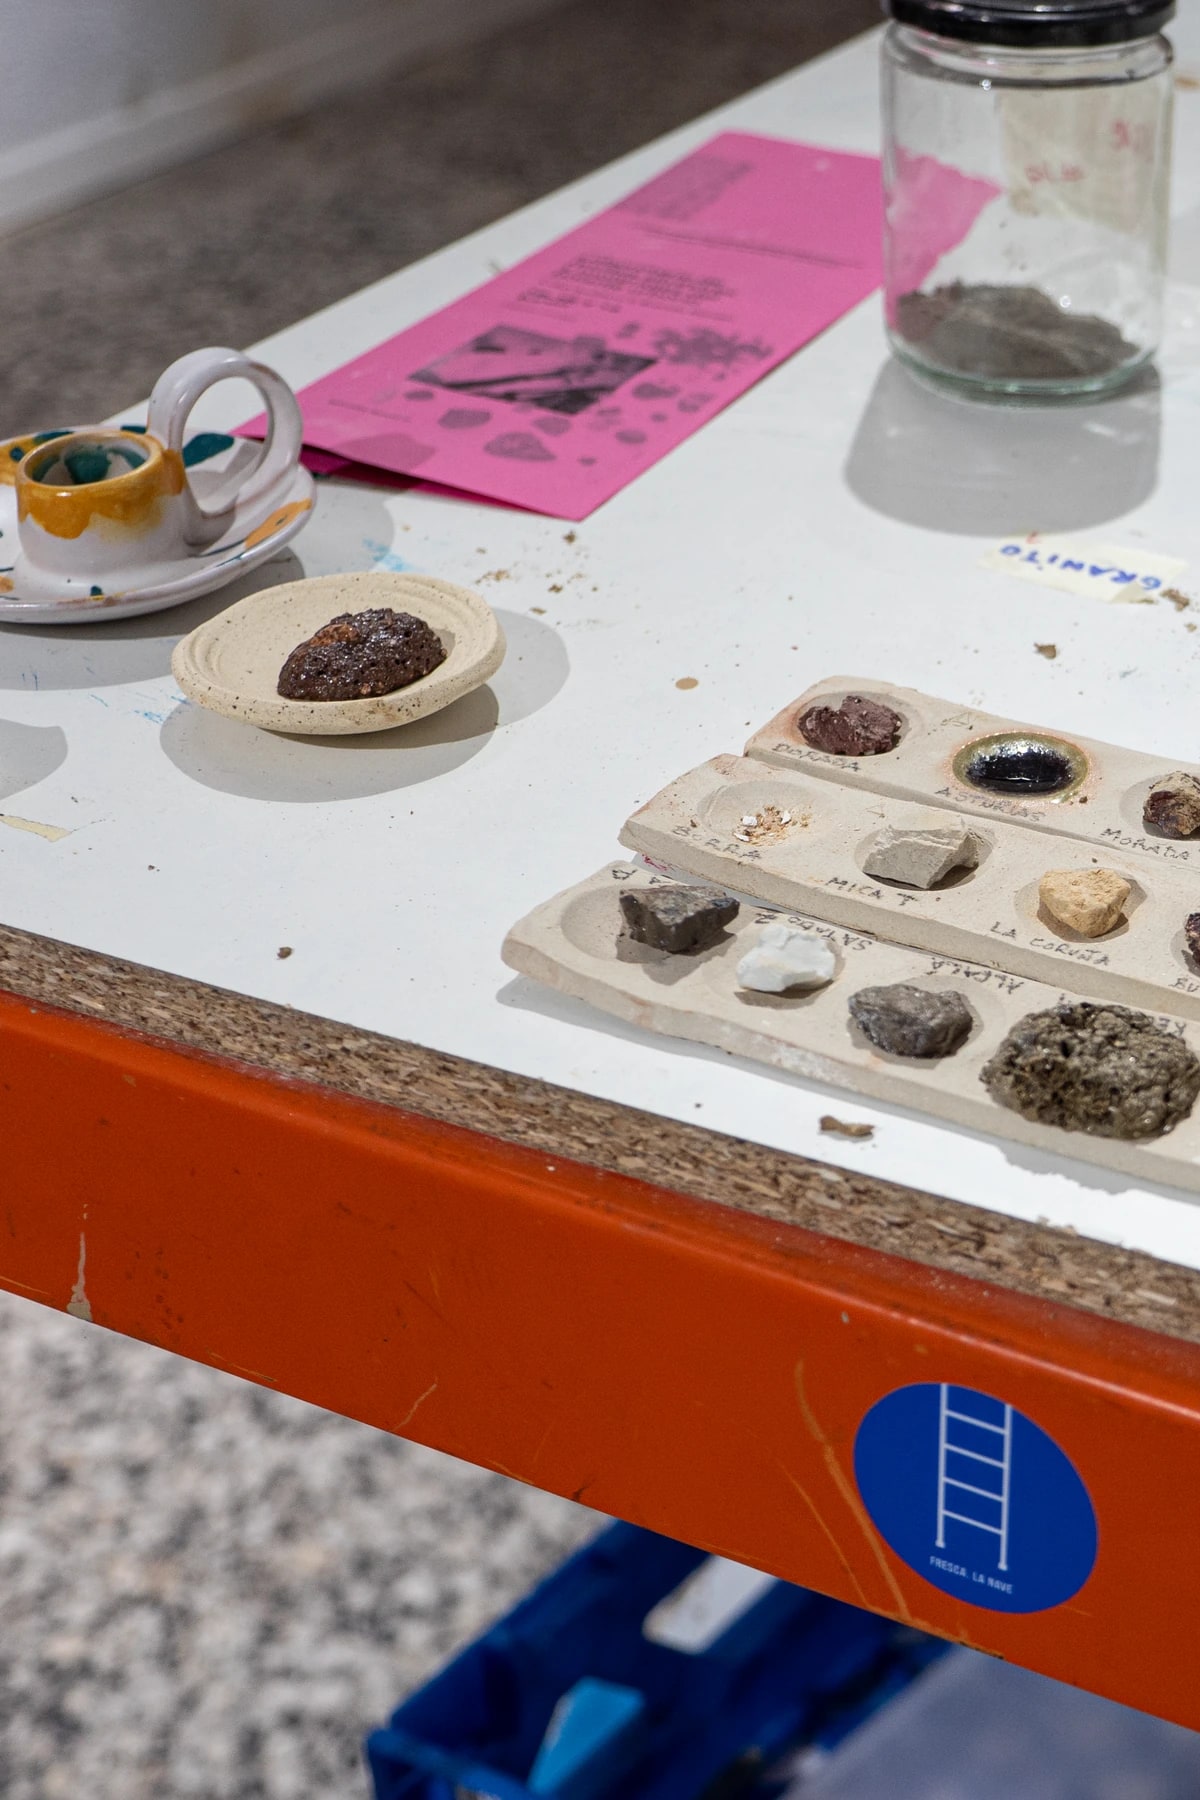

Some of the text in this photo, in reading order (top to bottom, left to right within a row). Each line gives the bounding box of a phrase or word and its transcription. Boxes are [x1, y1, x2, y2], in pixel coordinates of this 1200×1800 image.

[999, 543, 1162, 591] GRANITO
[934, 787, 1047, 822] ASTURIAS
[824, 876, 884, 900] MICA
[990, 920, 1110, 966] LA CORUÑA
[972, 1571, 985, 1585] LA
[987, 1576, 1013, 1594] NAVE
